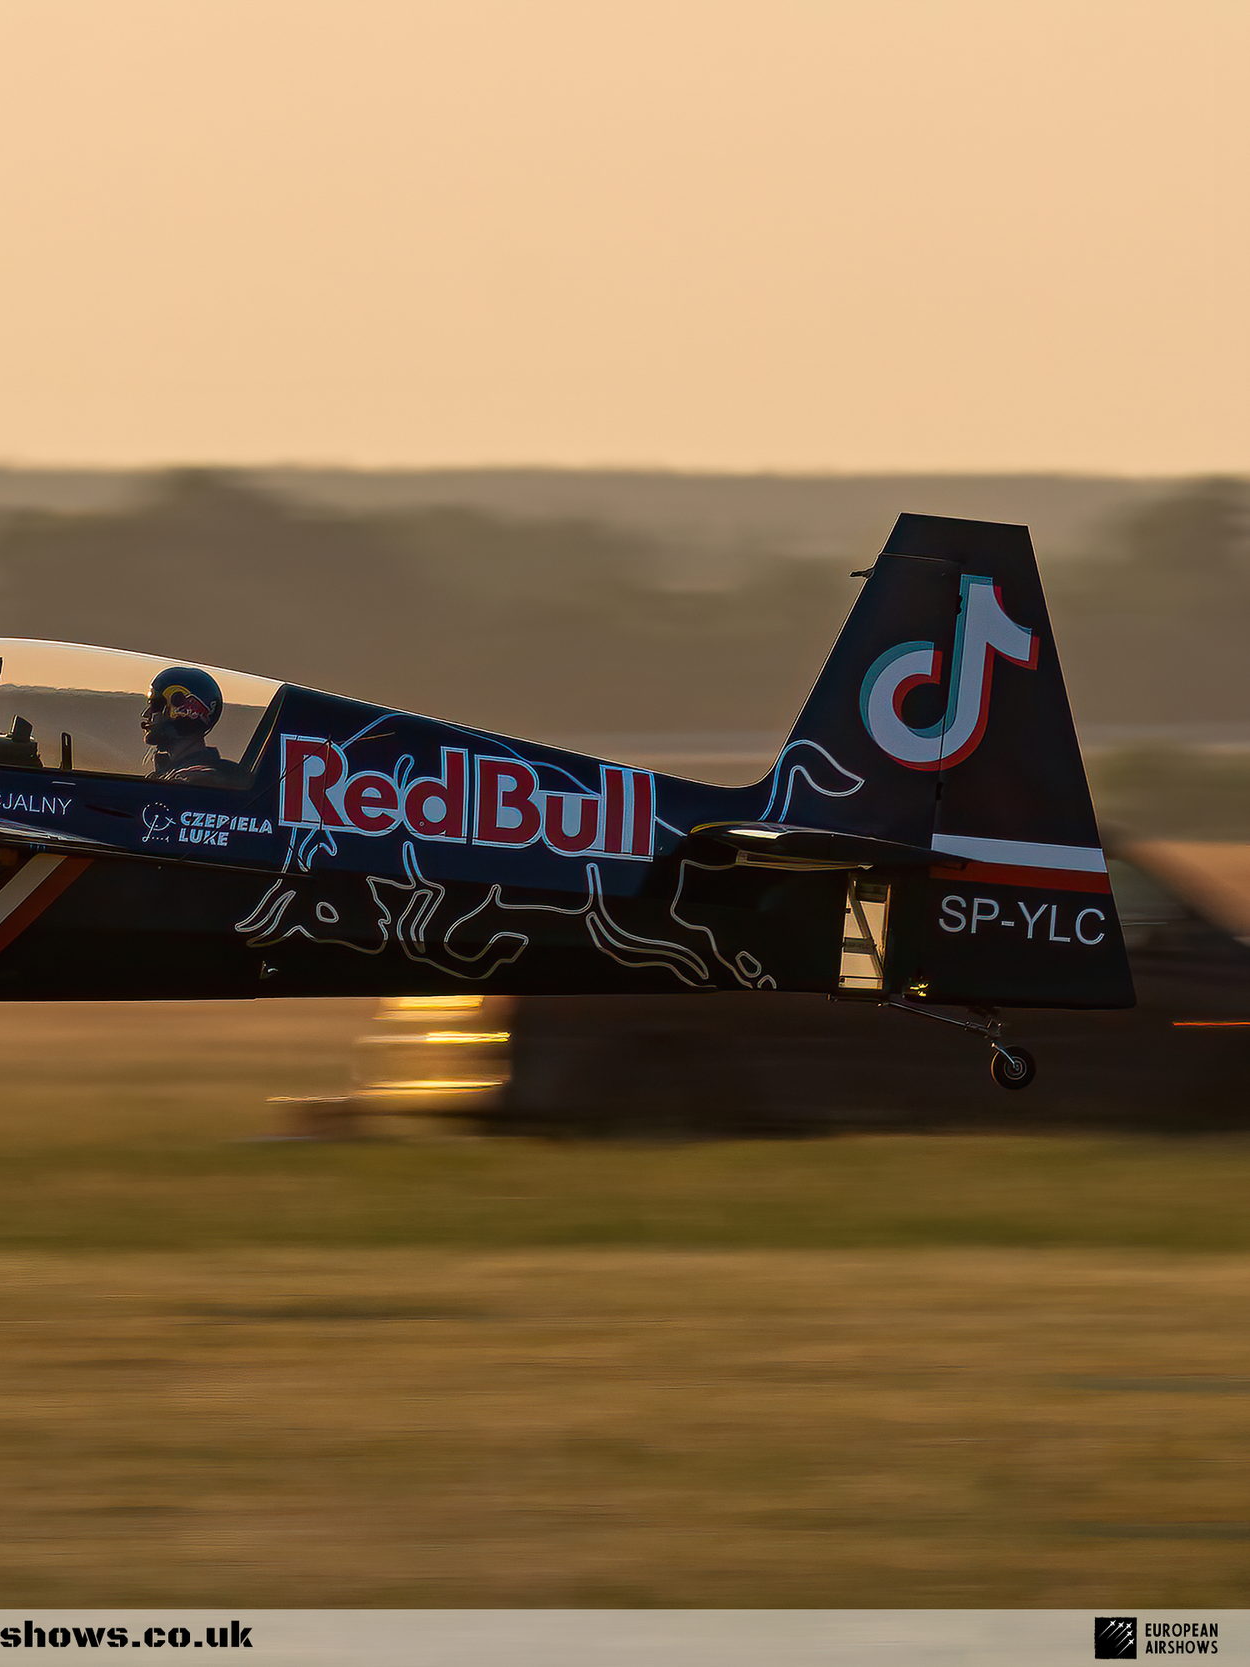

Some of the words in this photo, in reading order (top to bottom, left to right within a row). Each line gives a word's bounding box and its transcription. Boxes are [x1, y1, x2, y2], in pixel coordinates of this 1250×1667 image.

[180, 811, 273, 835] CZEPIELA
[178, 828, 230, 847] LUKE
[938, 894, 1106, 946] SP-YLC
